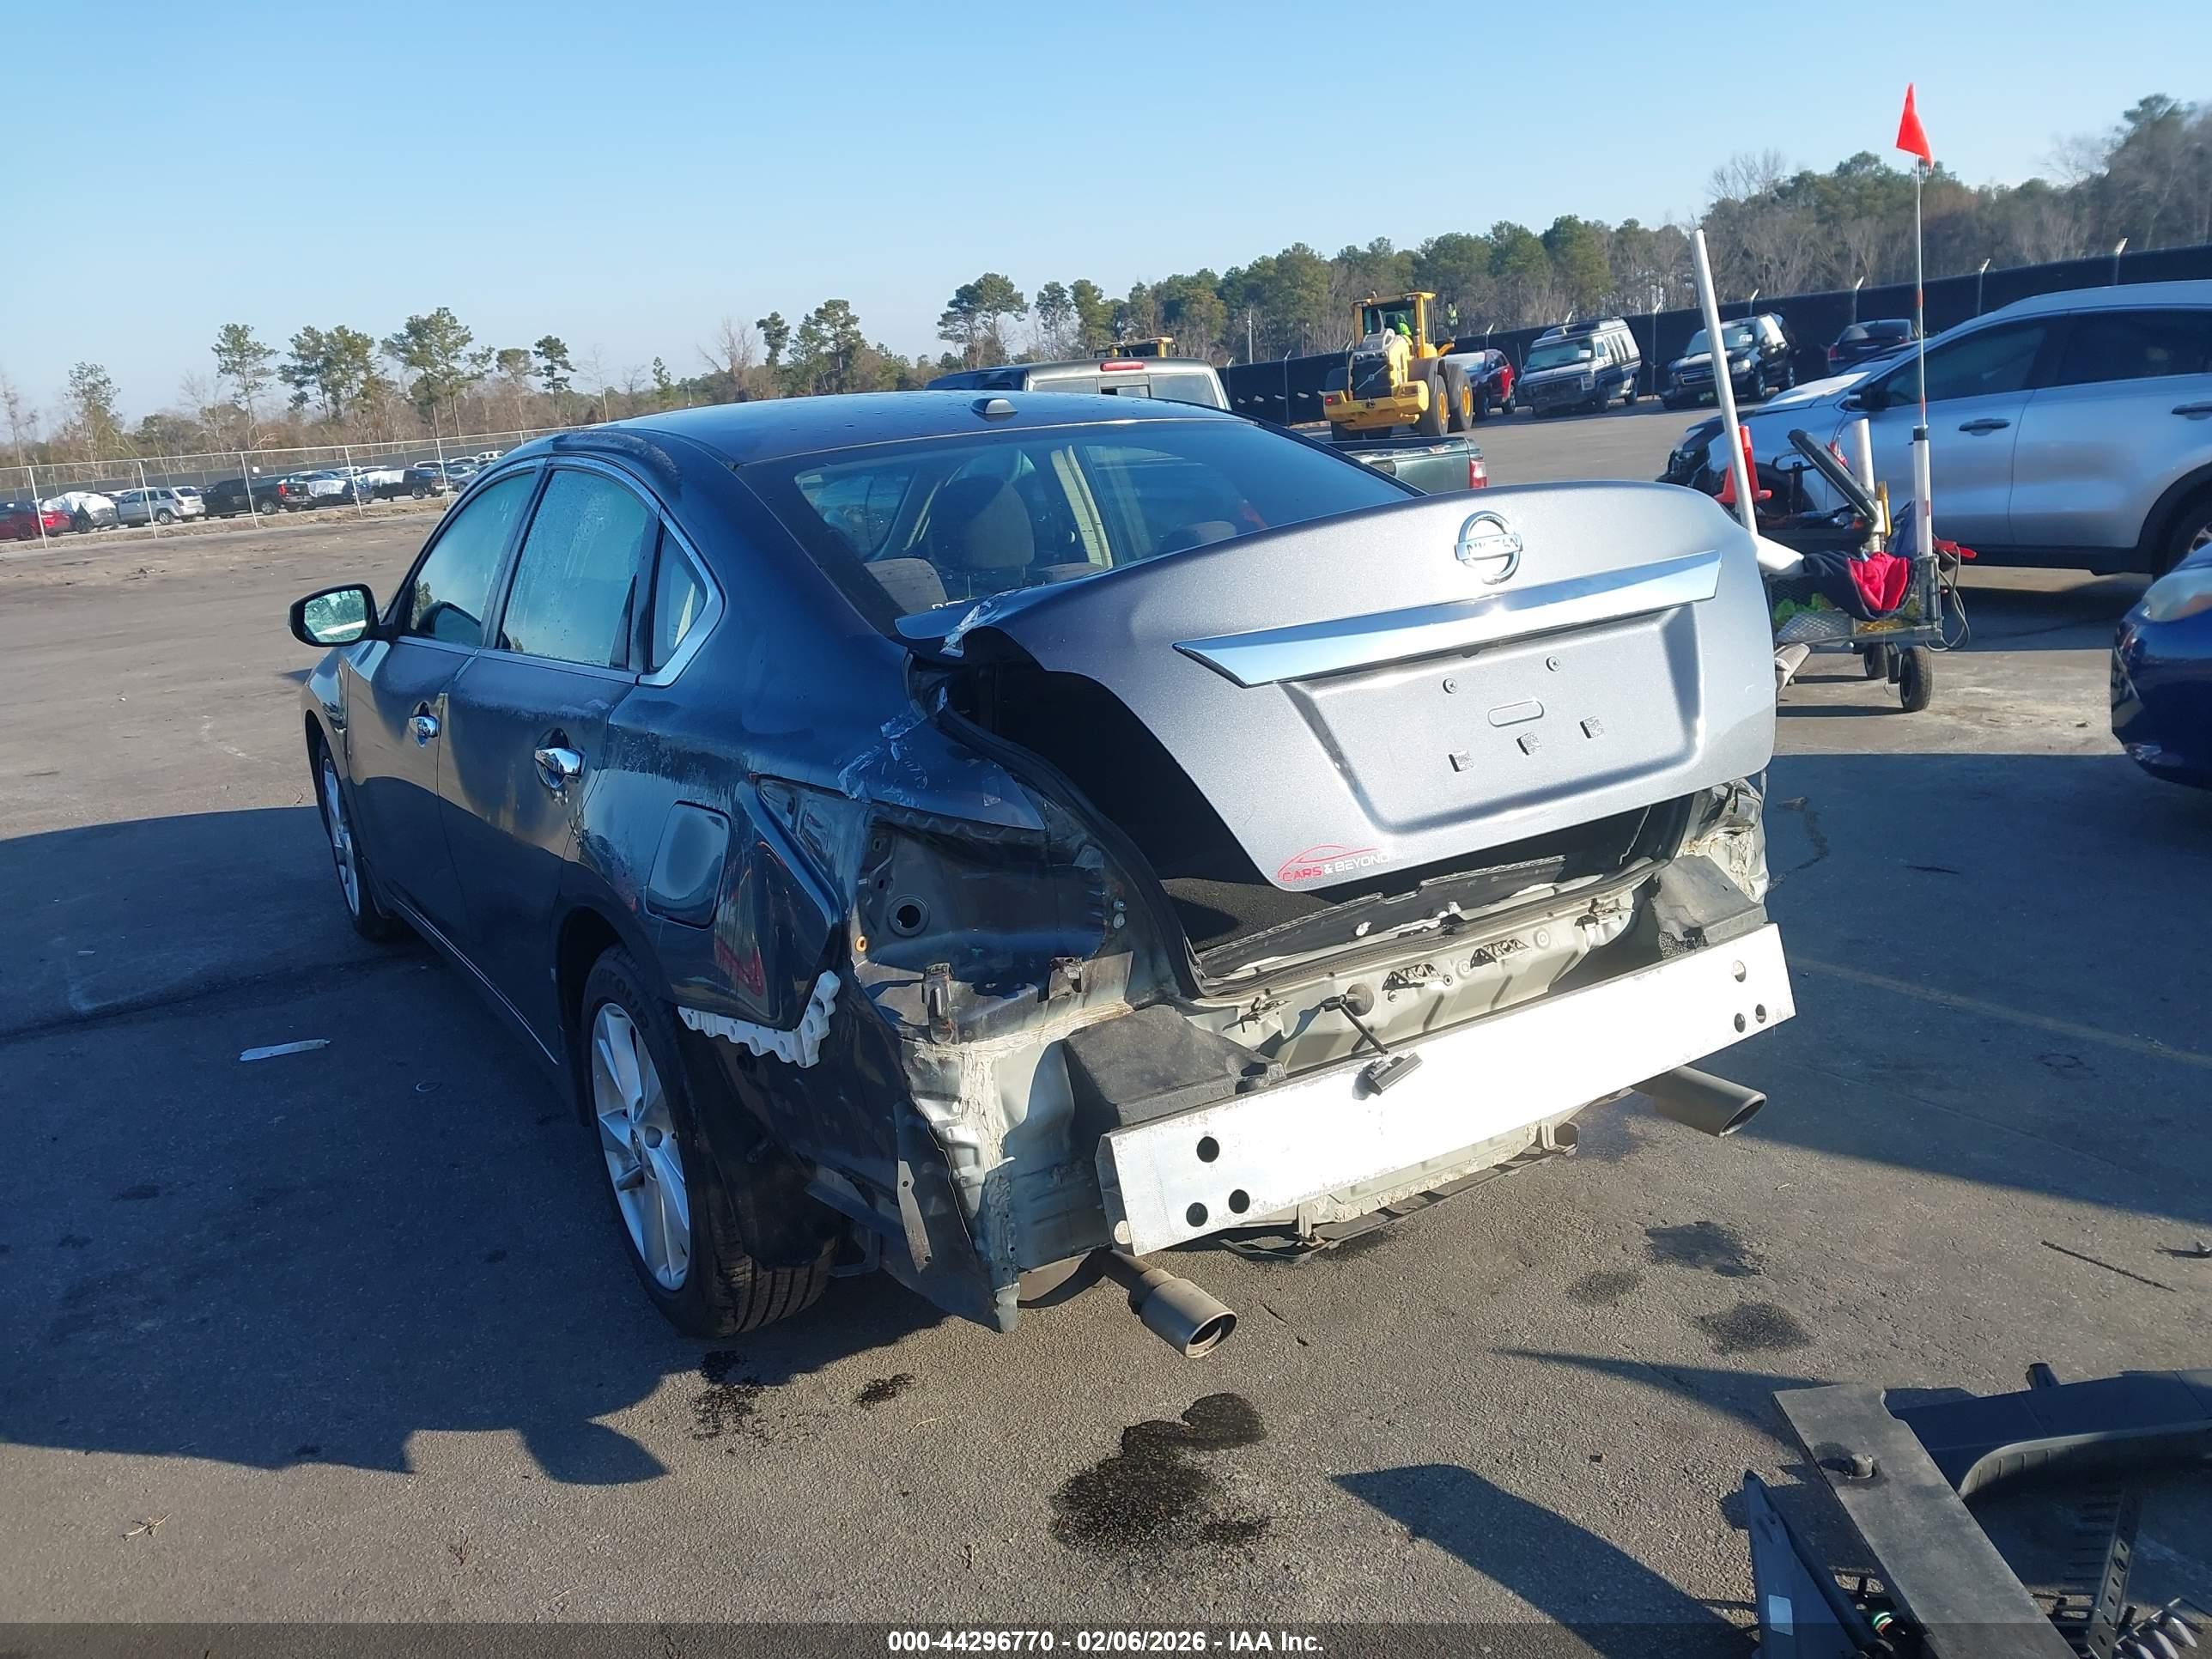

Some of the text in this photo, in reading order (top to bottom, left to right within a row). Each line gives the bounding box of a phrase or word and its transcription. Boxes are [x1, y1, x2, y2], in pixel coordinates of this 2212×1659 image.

[1282, 854, 1390, 882] CARS & BEYOND
